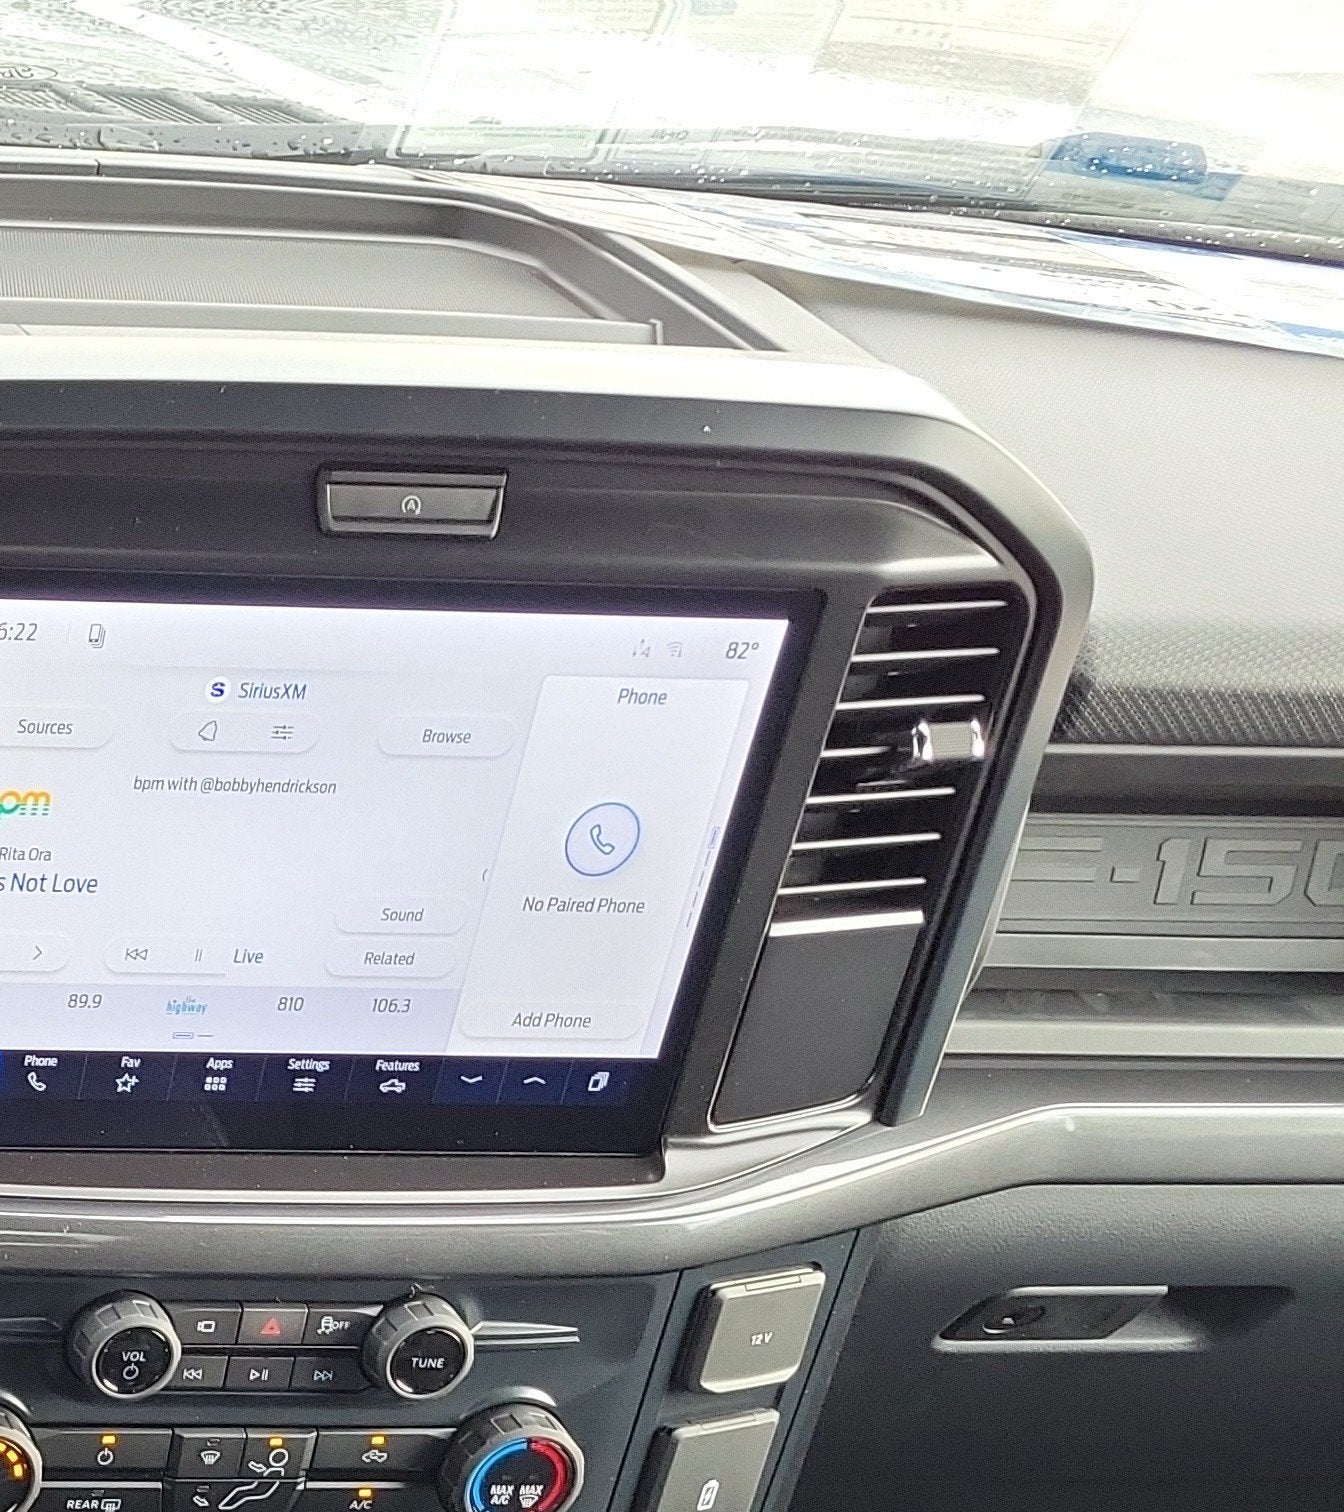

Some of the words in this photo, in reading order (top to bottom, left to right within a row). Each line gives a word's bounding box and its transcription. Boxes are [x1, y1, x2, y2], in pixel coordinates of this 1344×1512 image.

[725, 641, 760, 660] 82°
[238, 682, 307, 700] SiriusXM
[617, 688, 668, 705] Phone
[17, 718, 73, 735] Sources
[422, 729, 472, 744] Browse
[133, 776, 165, 793] bpm
[166, 777, 198, 791] with
[200, 777, 337, 795] @bobbyhendrickson
[28, 847, 52, 862] Ora
[11, 873, 48, 893] Not
[52, 874, 98, 894] Love
[522, 897, 544, 912] No
[546, 897, 595, 913] Paired
[597, 898, 645, 914] Phone
[380, 908, 424, 923] Sound
[233, 949, 264, 964] Live
[364, 951, 415, 966] Related
[67, 994, 102, 1009] 89.9
[165, 1000, 208, 1015] highway
[277, 997, 304, 1011] 810
[372, 998, 411, 1013] 106.3
[511, 1012, 543, 1028] Add
[544, 1013, 592, 1028] Phone
[24, 1054, 58, 1068] Phone
[120, 1056, 141, 1069] Fav
[205, 1057, 233, 1071] Apps
[287, 1057, 330, 1073] Settings
[375, 1058, 420, 1072] Features
[331, 1320, 351, 1331] OFF
[121, 1351, 146, 1363] VOL
[411, 1356, 445, 1370] TUNE
[490, 1484, 514, 1496] MAX
[519, 1484, 544, 1496] MAX
[66, 1500, 99, 1510] REAR
[349, 1500, 373, 1511] A/C
[490, 1494, 510, 1505] A/C
